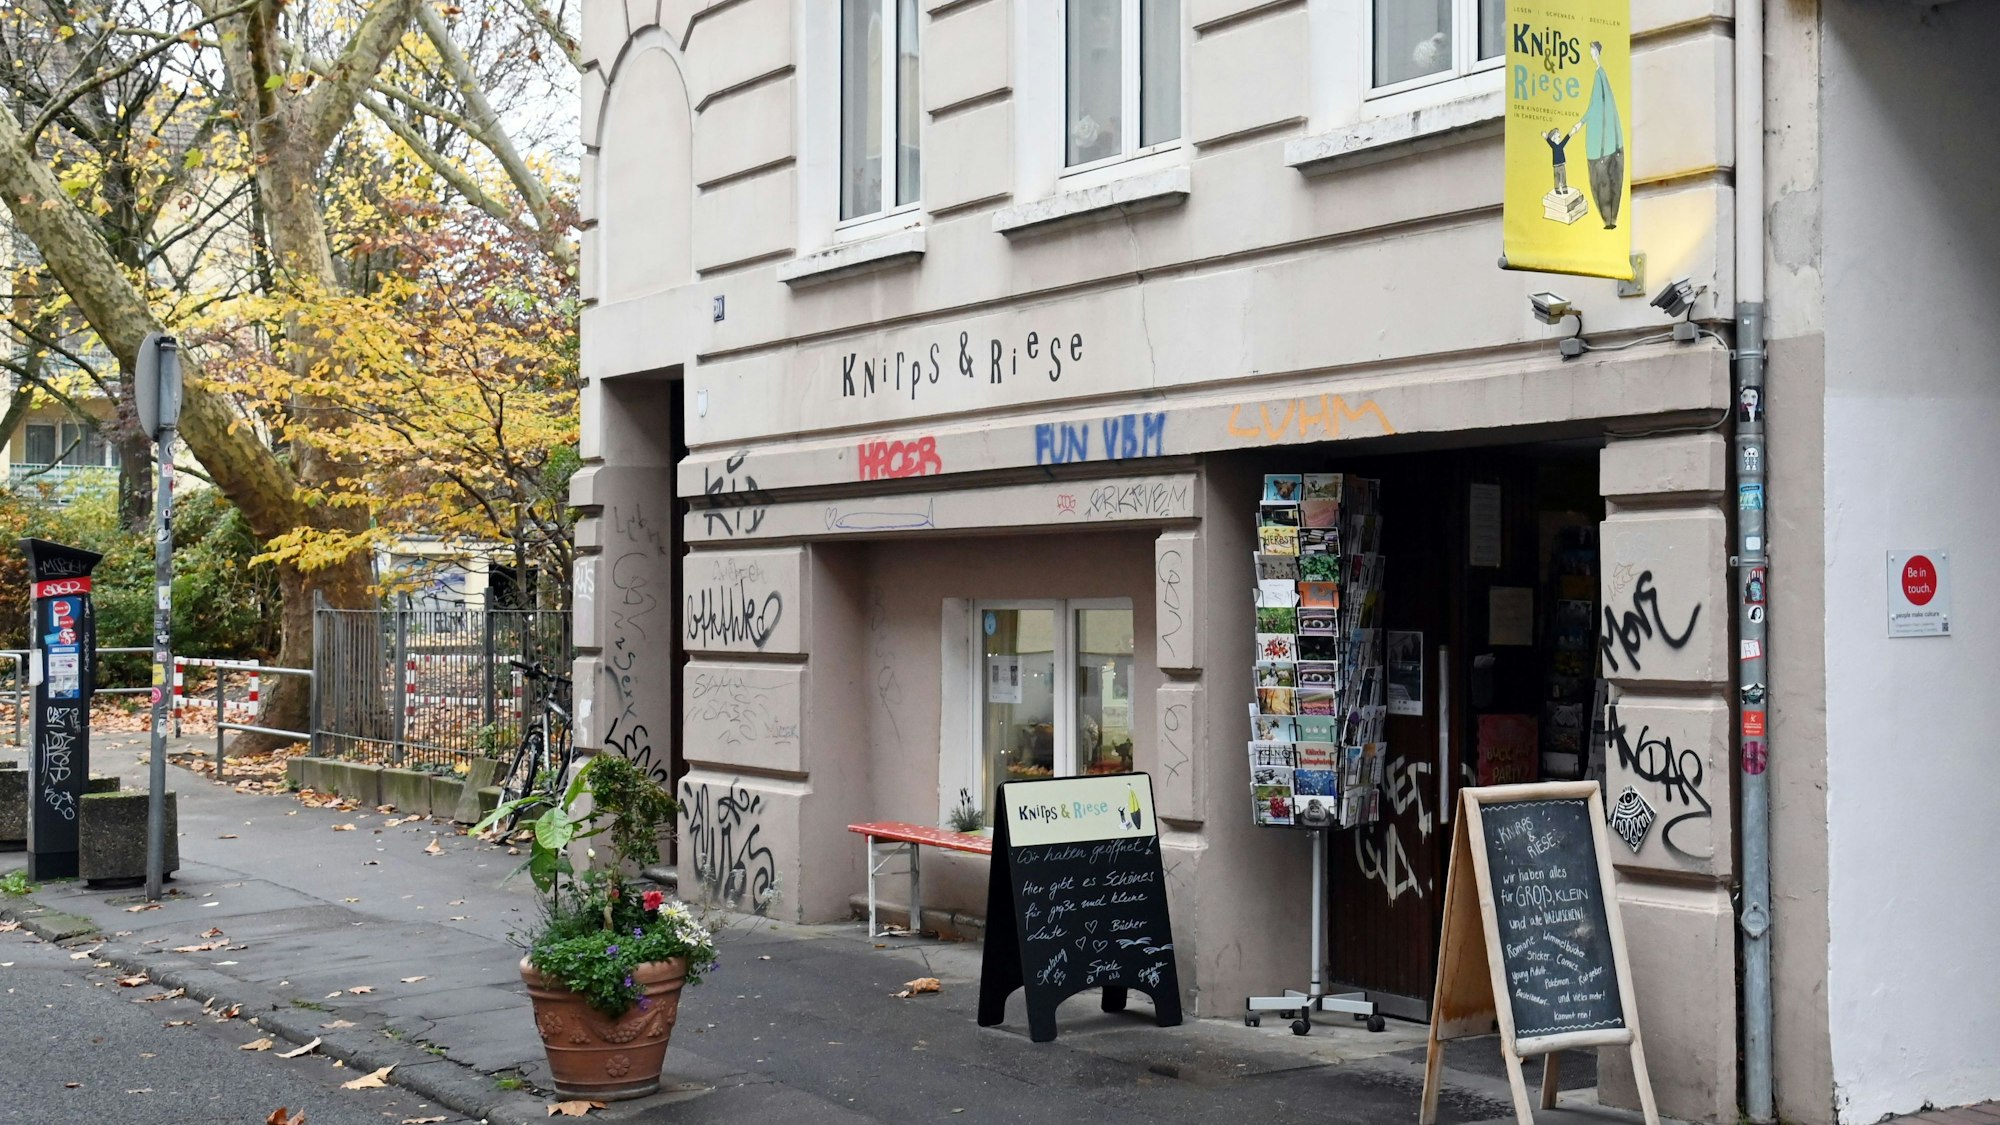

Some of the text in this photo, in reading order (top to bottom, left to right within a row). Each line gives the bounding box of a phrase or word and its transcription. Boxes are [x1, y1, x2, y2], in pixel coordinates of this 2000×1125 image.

[1543, 47, 1556, 74] &
[1514, 64, 1580, 102] Riese
[958, 331, 975, 378] &
[990, 331, 1083, 384] Riese
[1907, 567, 1927, 577] Be in
[1907, 583, 1932, 593] touch.
[1896, 611, 1911, 619] people
[1061, 803, 1070, 819] &
[1073, 801, 1108, 818] Riese
[1526, 831, 1537, 842] &
[1017, 847, 1040, 864] Wir
[1044, 846, 1086, 861] haben
[1503, 866, 1568, 884] wir haben alles
[1022, 870, 1155, 900] Hier gibt es Schönes
[1501, 889, 1513, 906] für
[1555, 888, 1589, 902] KLEIN
[1025, 902, 1041, 930] für
[1081, 895, 1107, 909] und
[1108, 919, 1148, 932] Bücher
[1509, 916, 1526, 931] und
[1557, 991, 1570, 1004] und
